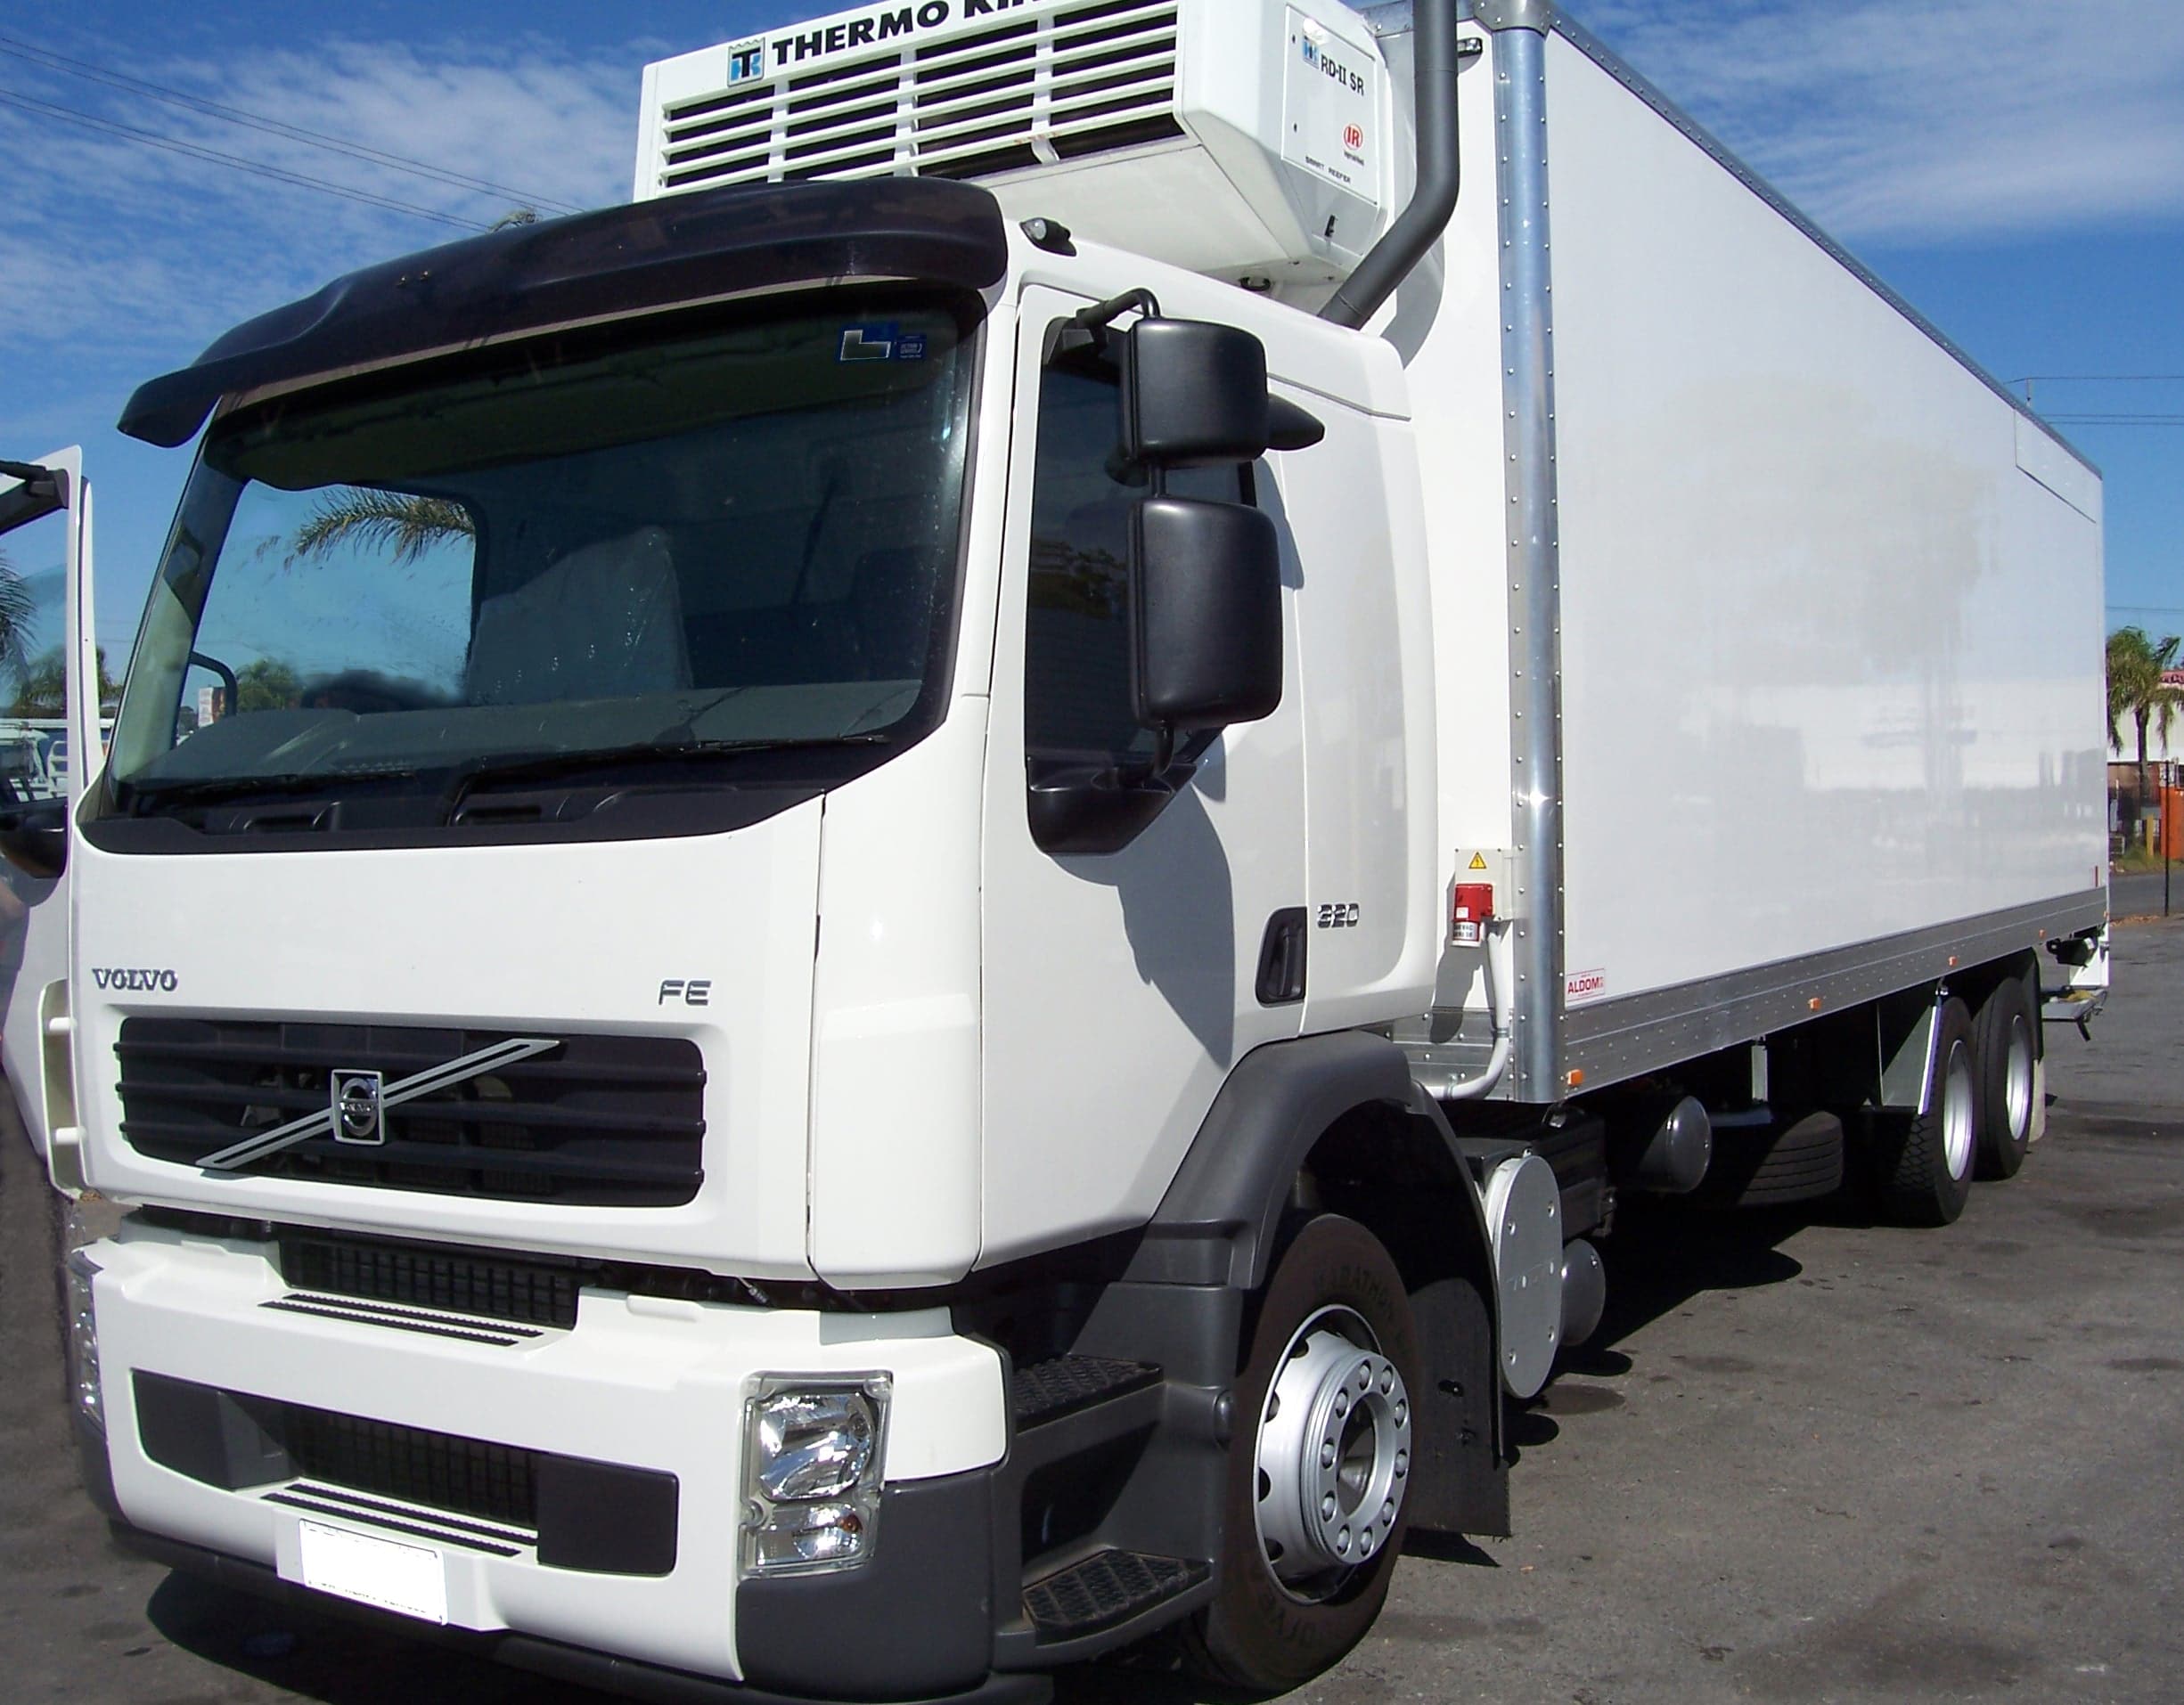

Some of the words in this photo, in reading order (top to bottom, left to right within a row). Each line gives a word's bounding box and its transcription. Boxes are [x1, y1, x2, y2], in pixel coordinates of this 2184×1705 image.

[773, 0, 950, 66] THERMO
[1350, 72, 1364, 95] SR
[92, 968, 178, 991] VOLVO
[658, 980, 711, 1006] FE
